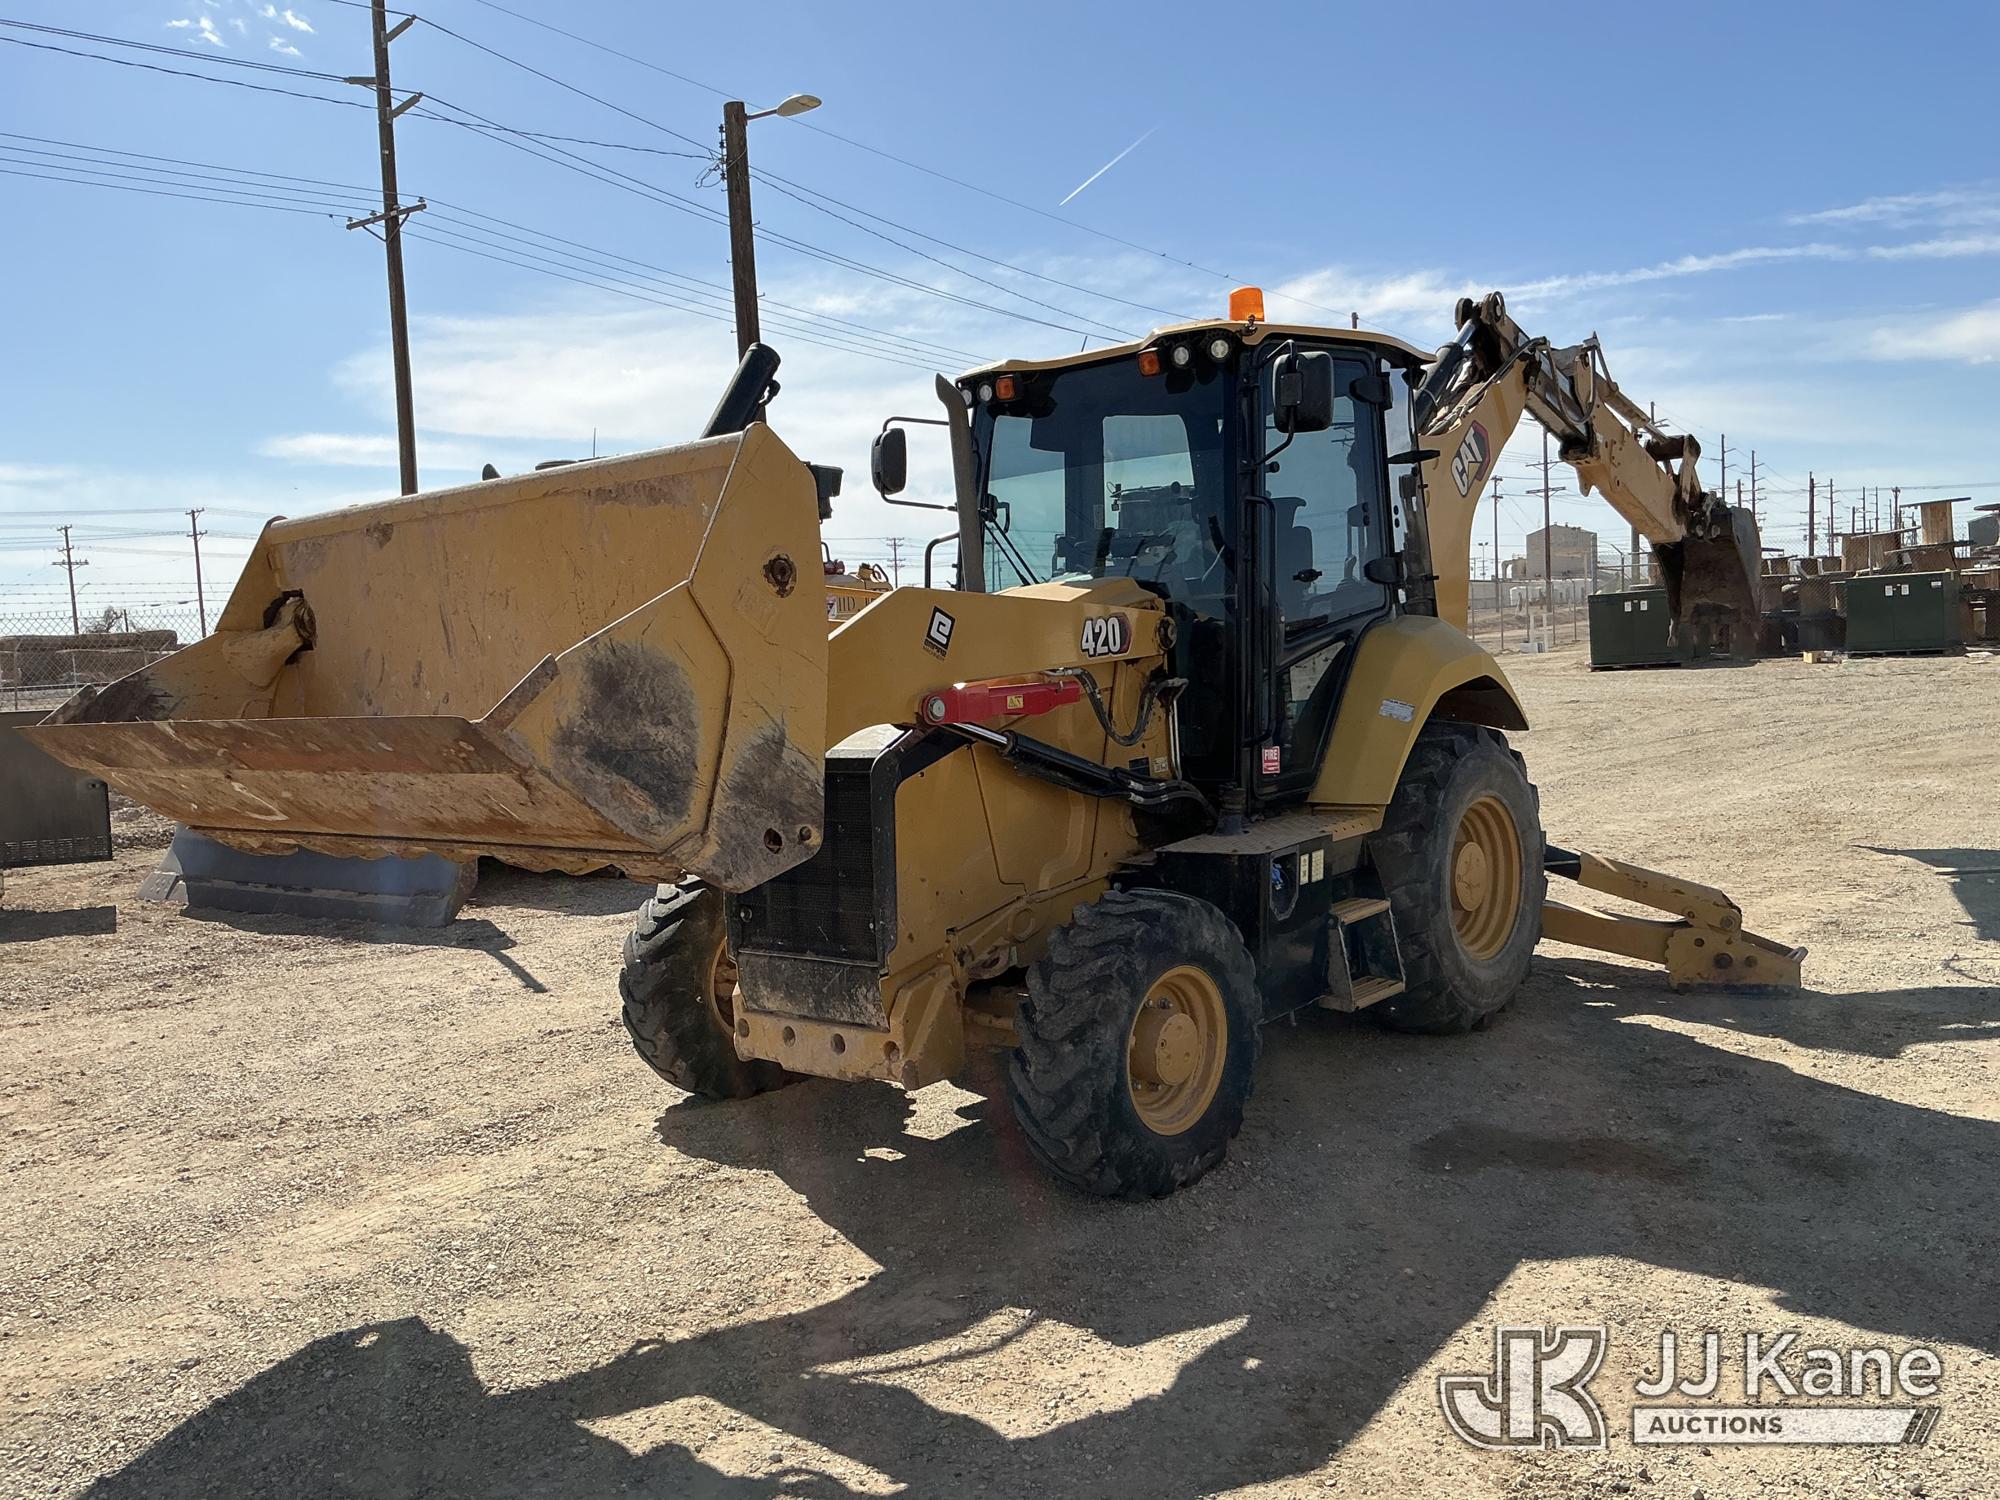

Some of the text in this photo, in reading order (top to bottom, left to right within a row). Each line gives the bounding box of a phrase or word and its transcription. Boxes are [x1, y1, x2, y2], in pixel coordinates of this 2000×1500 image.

[1452, 426, 1483, 496] CAT
[1081, 616, 1121, 656] 420
[1264, 748, 1278, 760] FIRE
